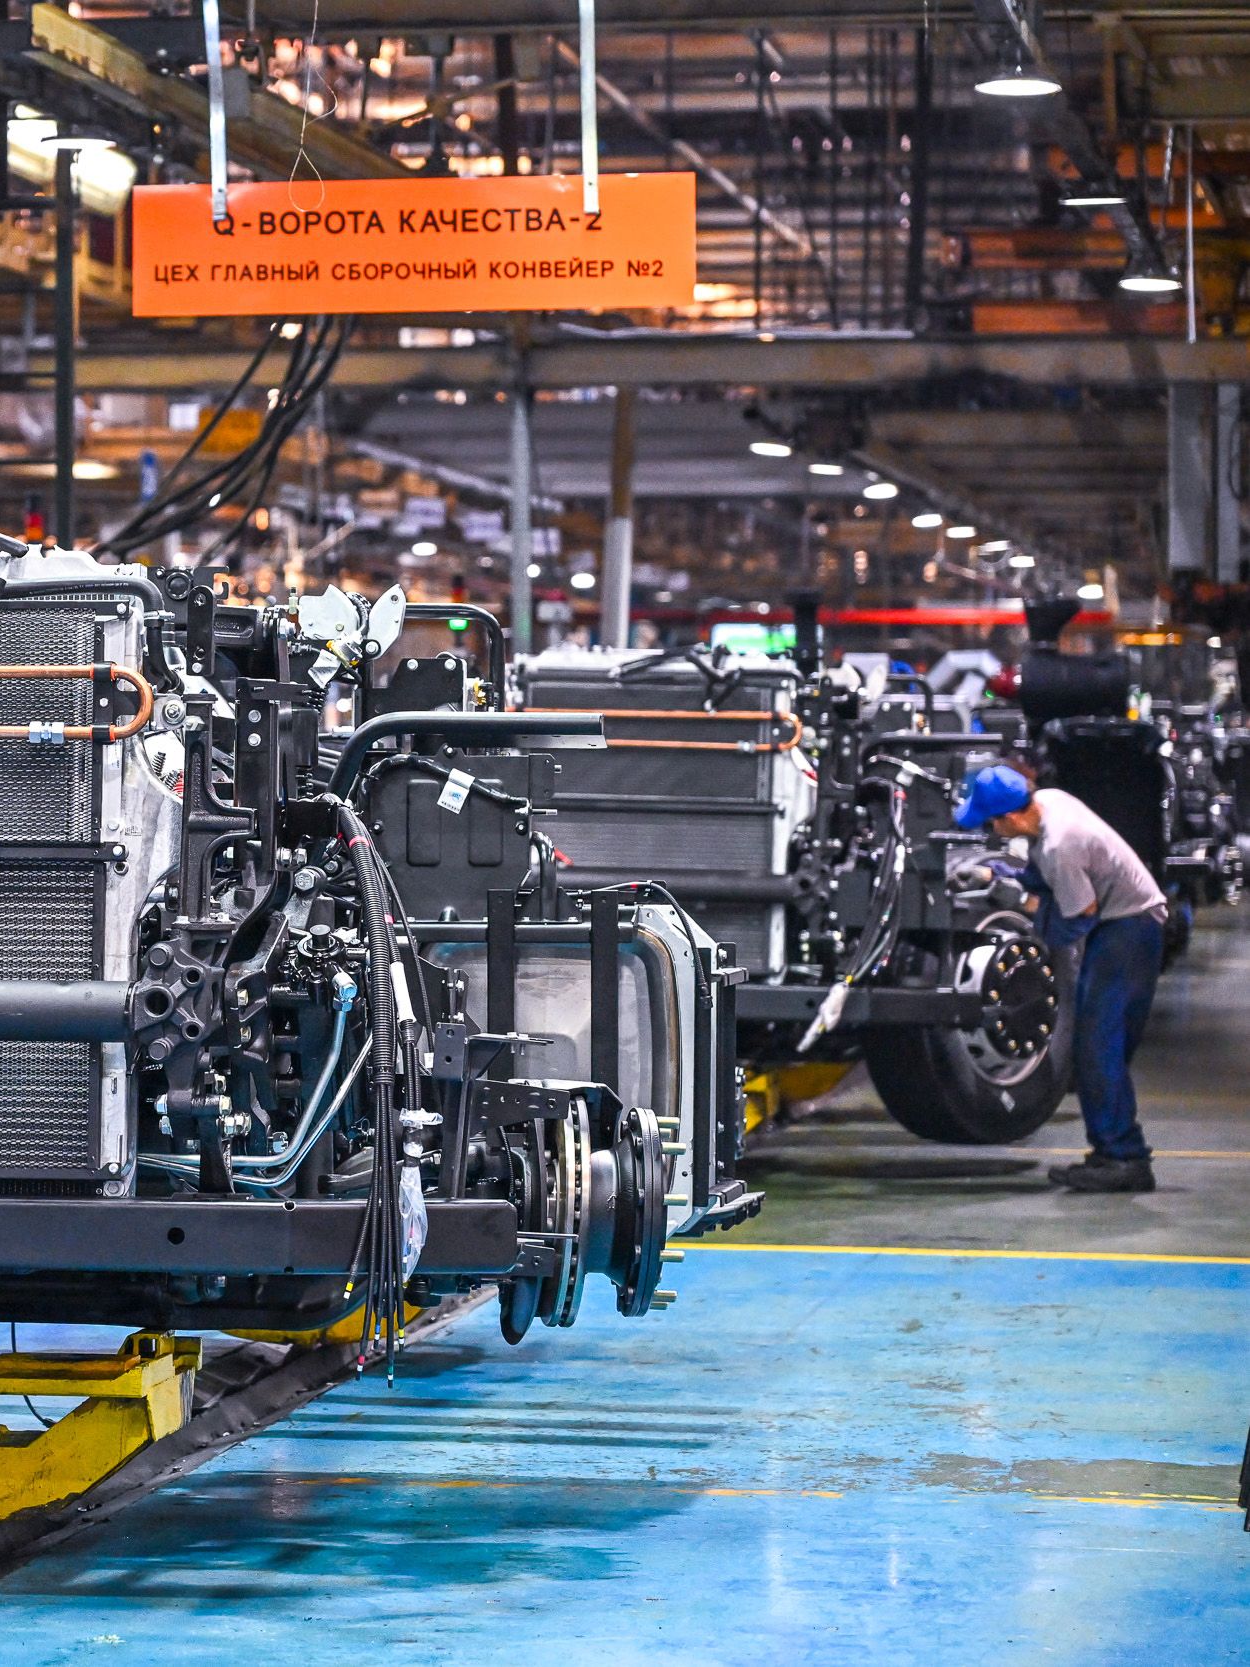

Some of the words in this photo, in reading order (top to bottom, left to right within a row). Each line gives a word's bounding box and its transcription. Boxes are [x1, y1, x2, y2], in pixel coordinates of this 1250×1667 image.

[399, 208, 602, 233] КАЧЕСТВА-2
[154, 264, 199, 286] ЦЕХ
[211, 260, 320, 282] ГЛАВНЫЙ
[331, 258, 477, 281] СБОРОЧНЫЙ
[489, 256, 614, 280] КОНВЕЙЕР
[626, 259, 664, 278] №2
